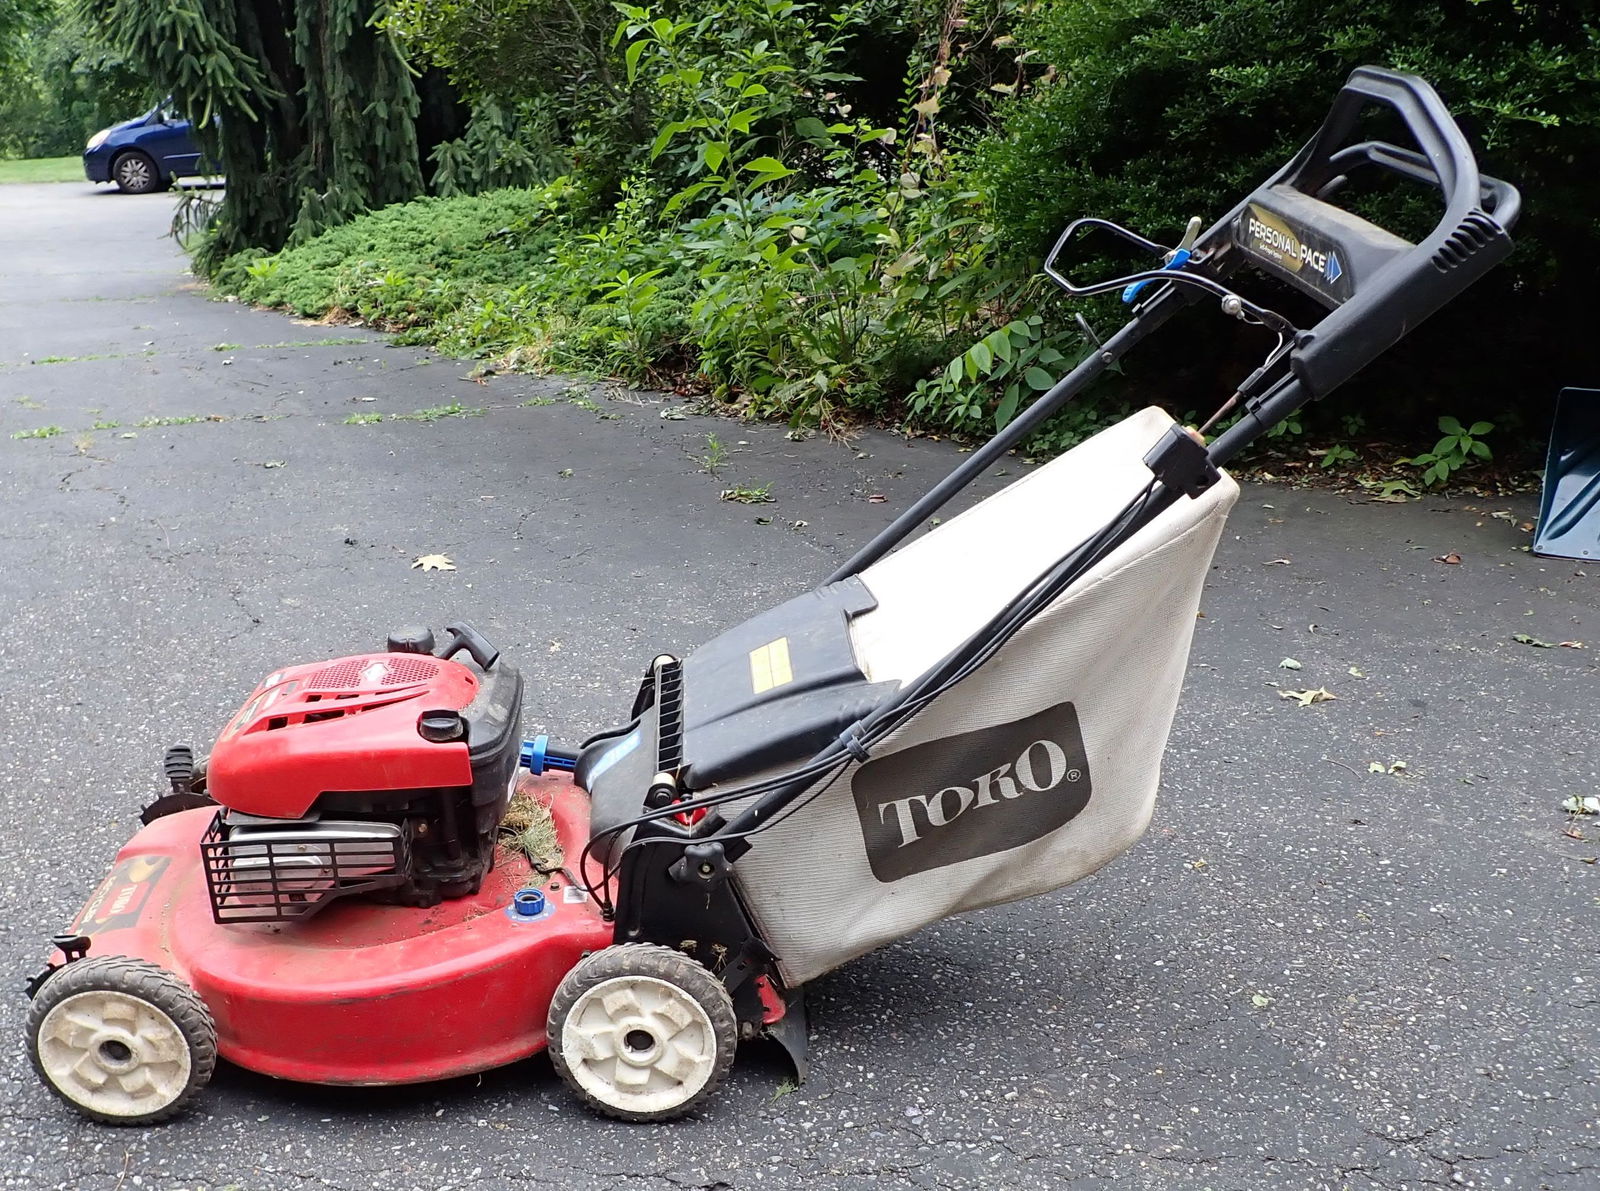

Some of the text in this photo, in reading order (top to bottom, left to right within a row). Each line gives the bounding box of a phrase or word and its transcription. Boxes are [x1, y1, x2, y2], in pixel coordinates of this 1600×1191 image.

[1248, 218, 1297, 258] PERSONAL
[1299, 244, 1327, 273] PACE
[878, 739, 1068, 848] TORO
